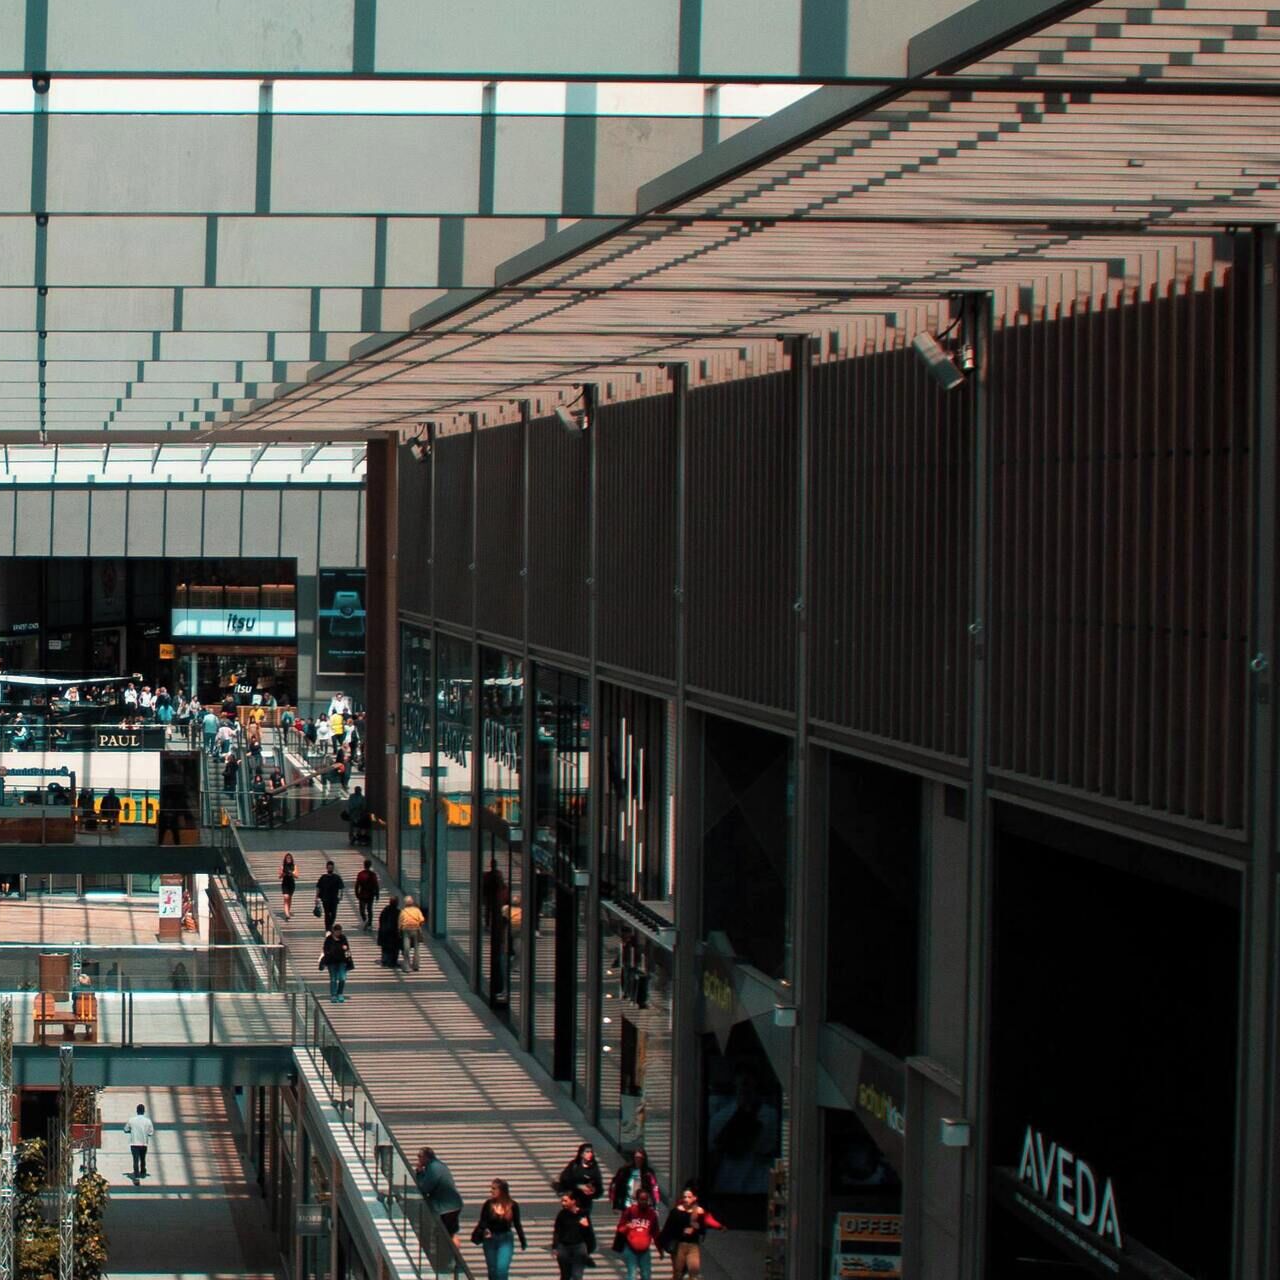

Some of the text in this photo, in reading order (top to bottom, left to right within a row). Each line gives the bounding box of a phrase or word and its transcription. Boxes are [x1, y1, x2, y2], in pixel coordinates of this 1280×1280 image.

[227, 613, 255, 631] itsu
[234, 683, 252, 694] itsu
[99, 734, 140, 747] PAUL
[1019, 1124, 1123, 1249] AVEDA
